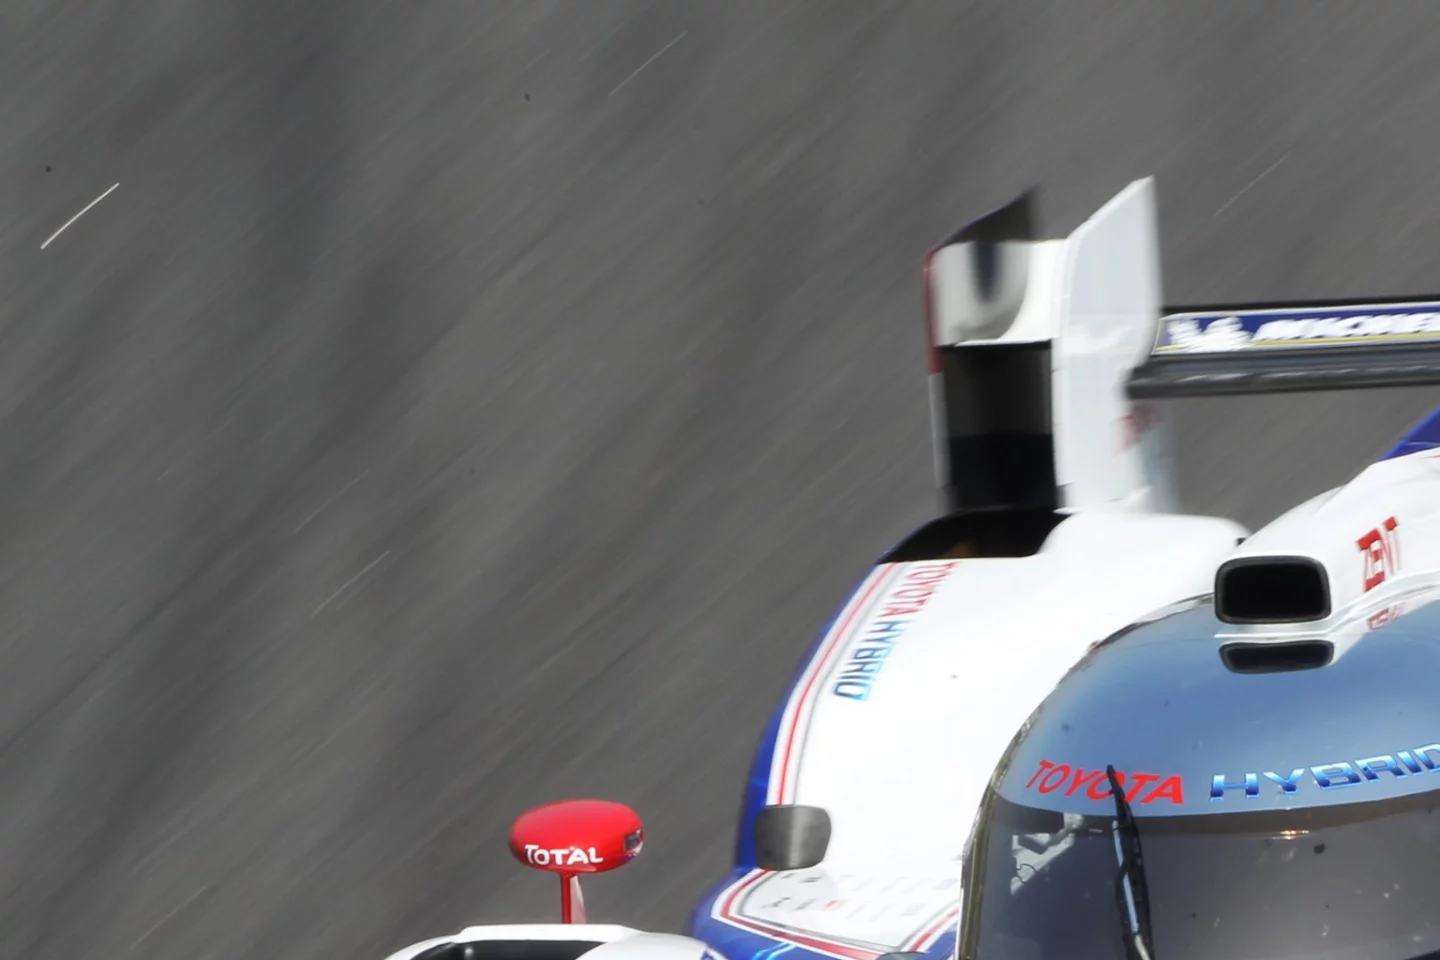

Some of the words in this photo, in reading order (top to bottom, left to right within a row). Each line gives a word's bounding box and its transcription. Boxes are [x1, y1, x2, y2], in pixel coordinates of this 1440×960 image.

[876, 562, 958, 618] TOYOTA
[834, 618, 915, 700] HYBRID
[1026, 759, 1186, 804] TOYOTA
[524, 843, 604, 866] TOTAL
